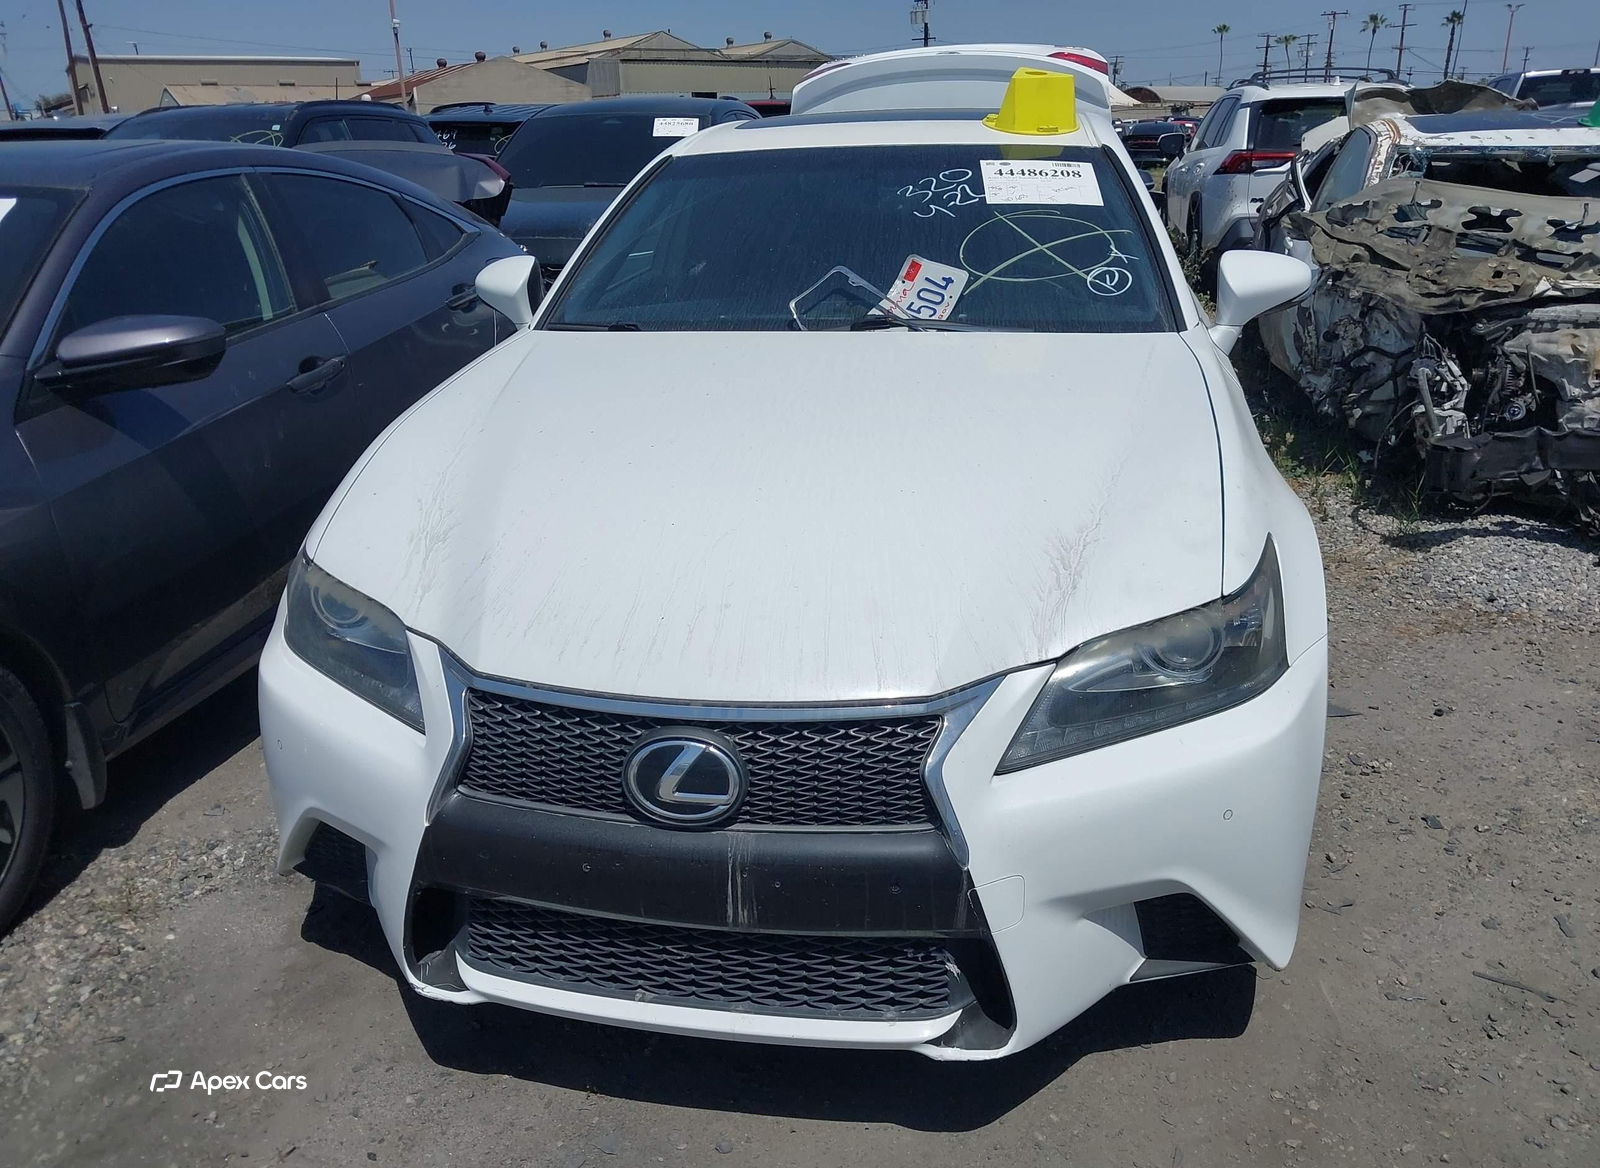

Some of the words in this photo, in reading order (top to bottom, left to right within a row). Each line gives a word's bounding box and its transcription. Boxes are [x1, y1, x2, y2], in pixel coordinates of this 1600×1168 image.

[896, 168, 973, 204] 320
[993, 168, 1082, 179] 44486208
[906, 276, 955, 319] 504
